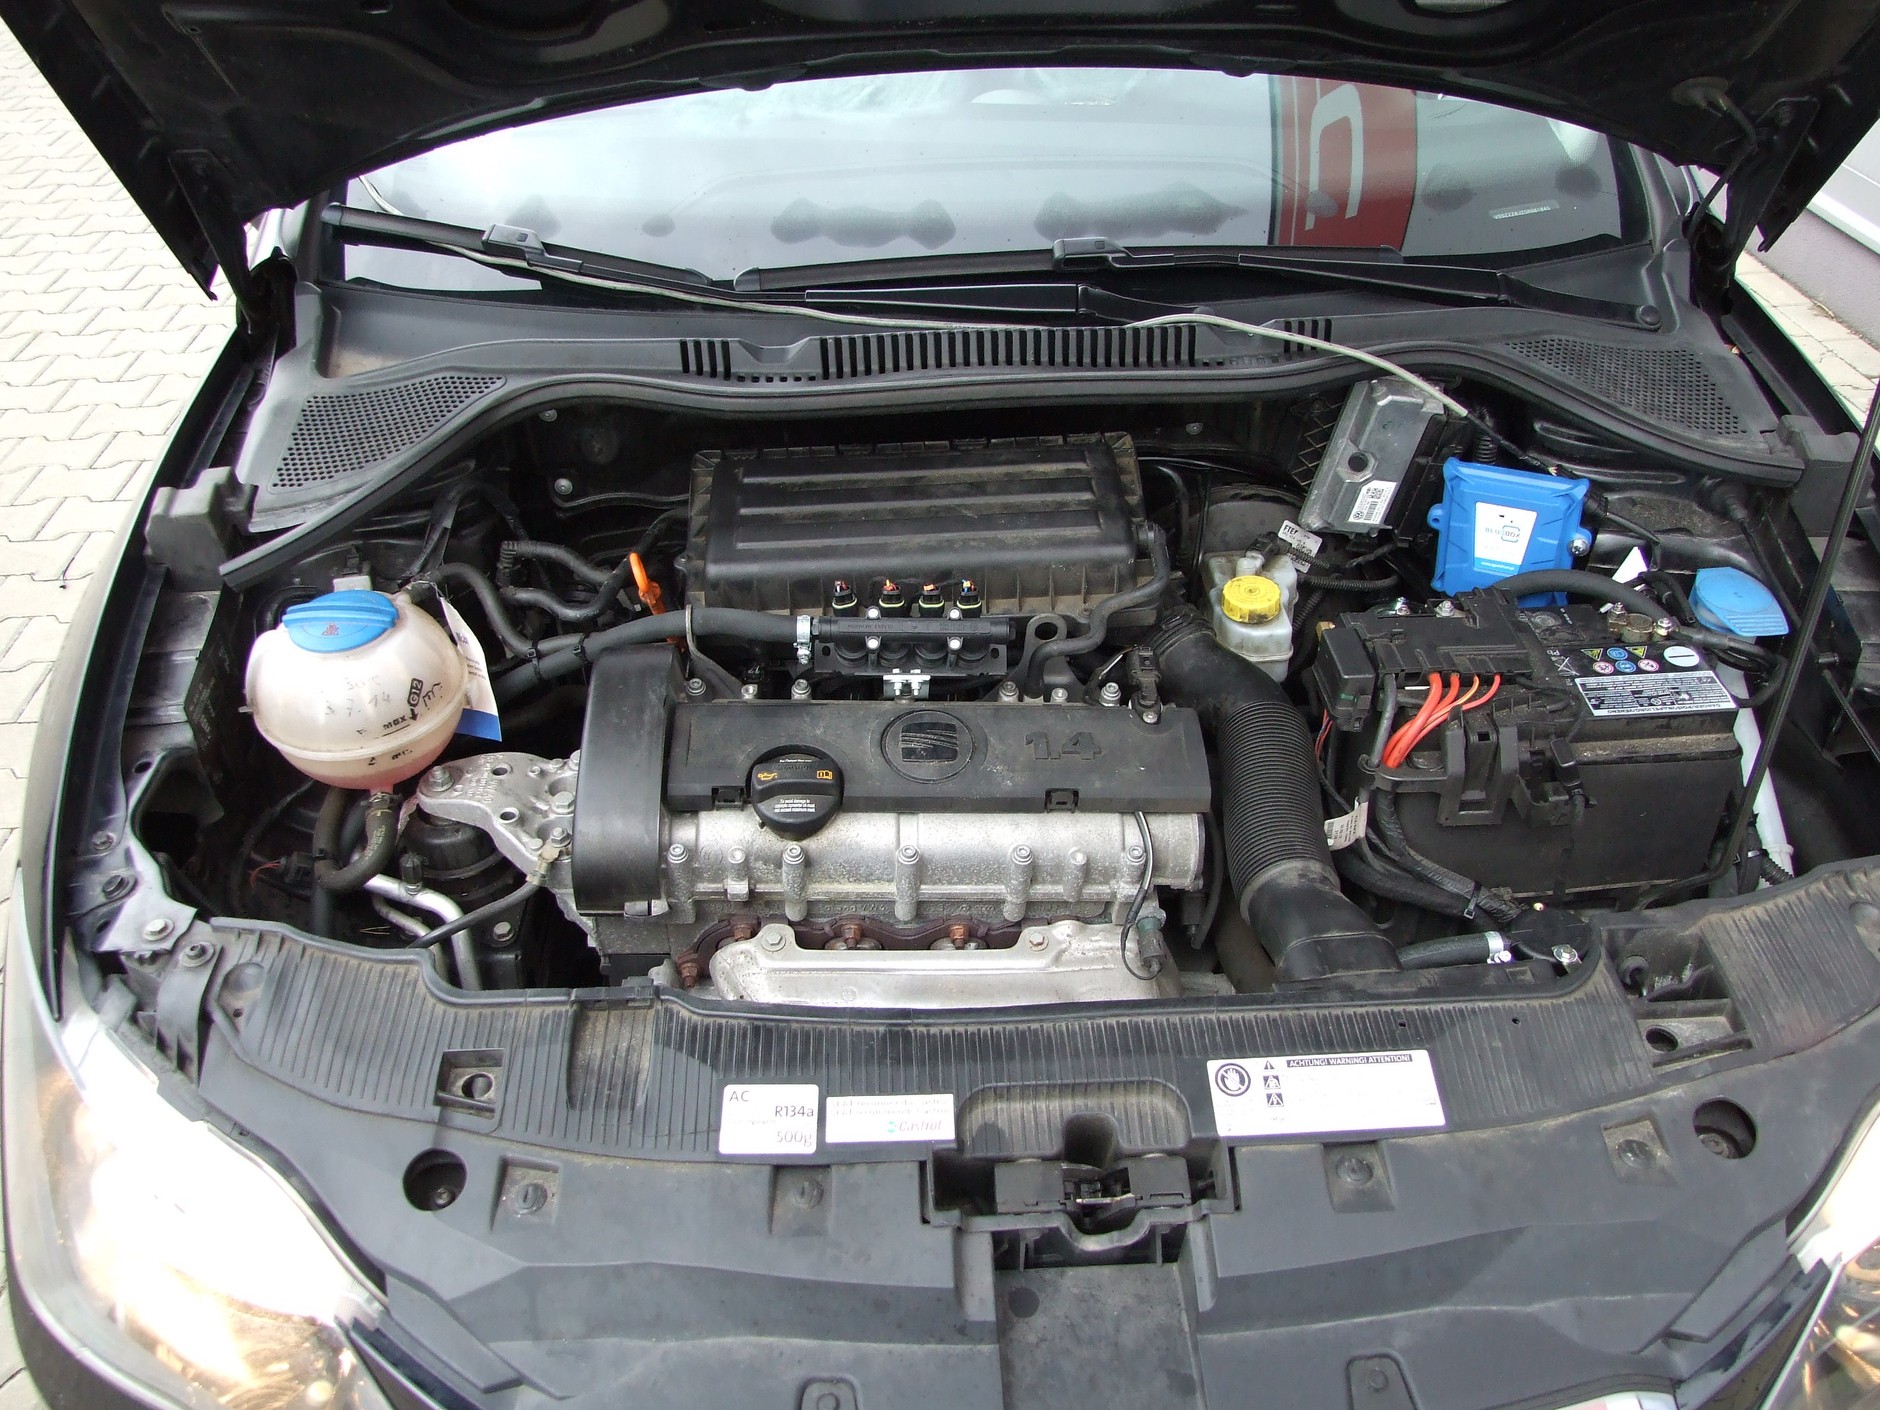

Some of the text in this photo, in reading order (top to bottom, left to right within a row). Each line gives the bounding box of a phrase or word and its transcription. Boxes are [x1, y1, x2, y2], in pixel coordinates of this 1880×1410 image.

[1024, 731, 1103, 760] 1.4
[1289, 1055, 1411, 1067] ACHTUNG! WARNING! ATTENTION!
[728, 1090, 750, 1102] AC
[775, 1104, 814, 1118] R134a
[776, 1130, 813, 1147] 500g
